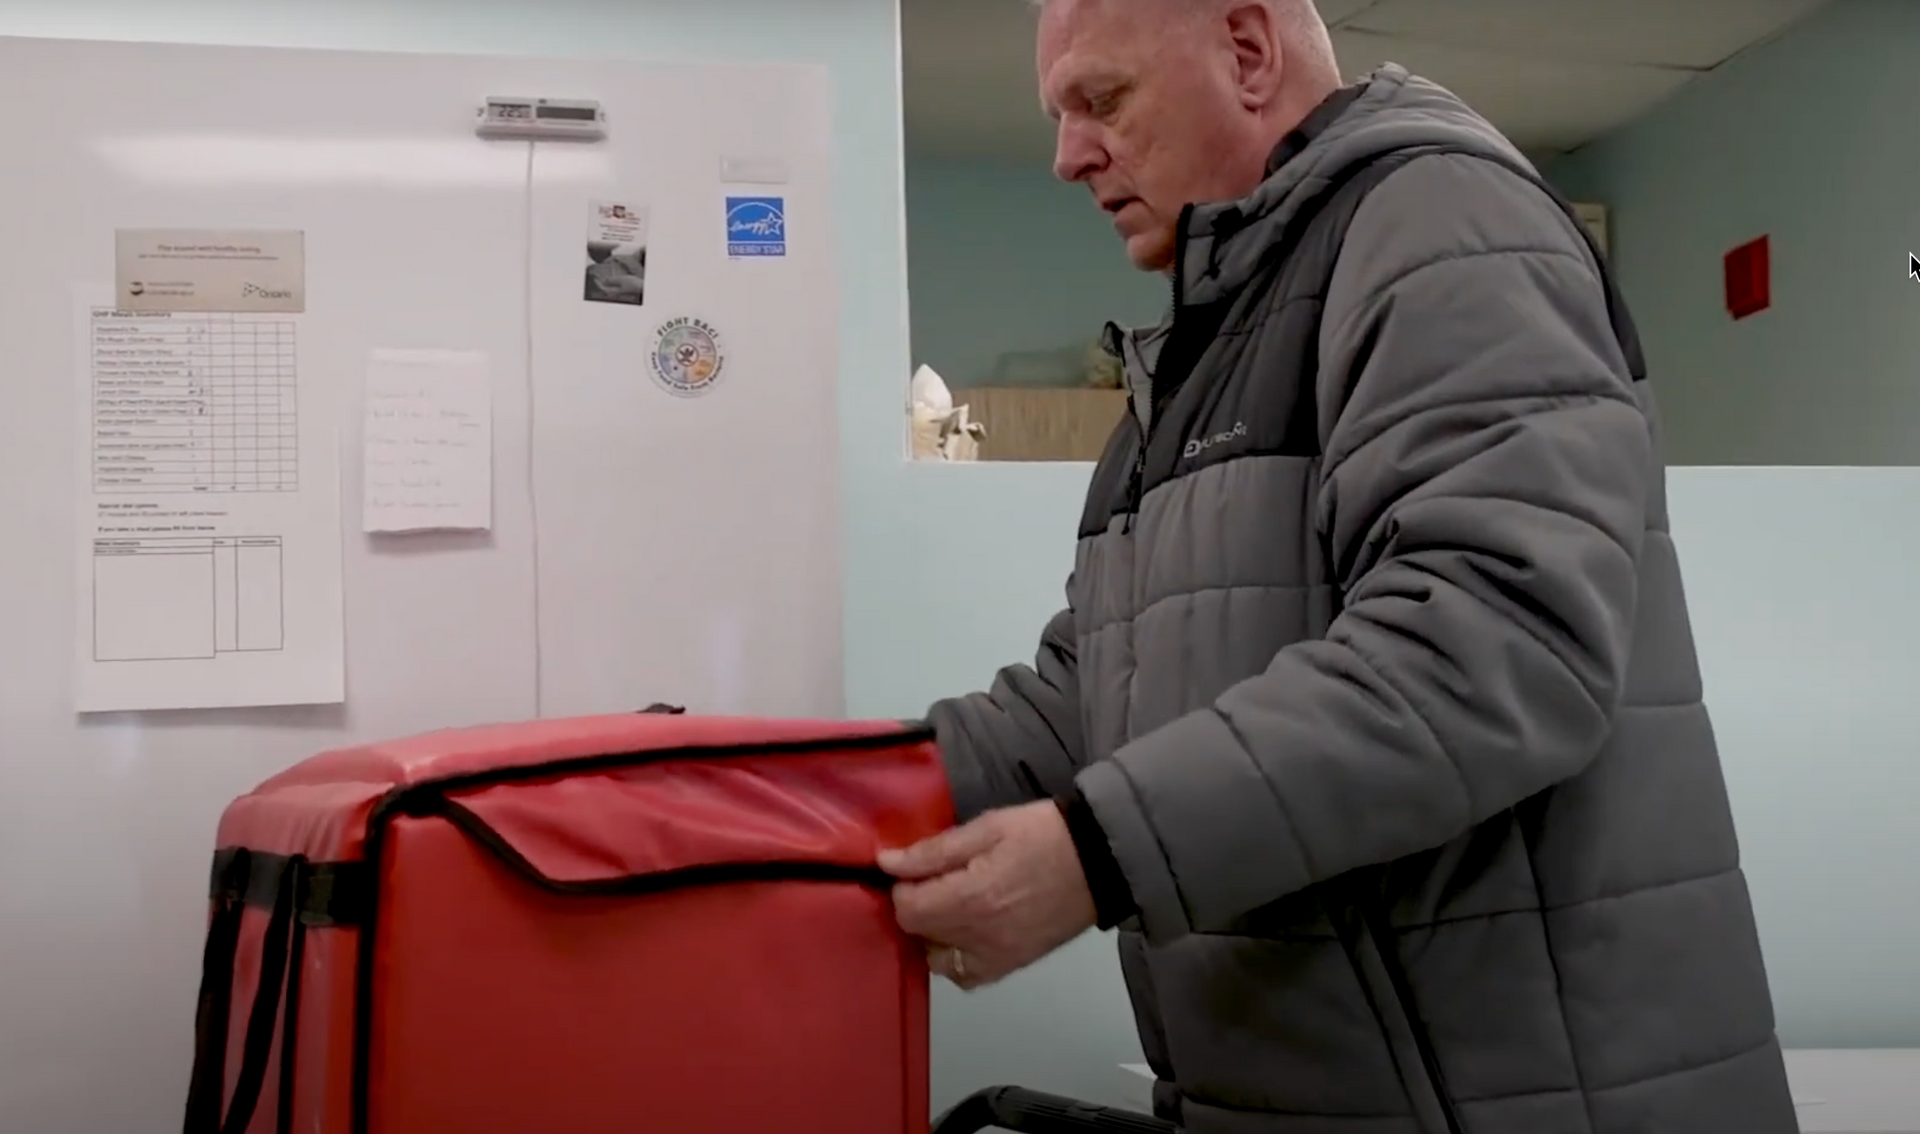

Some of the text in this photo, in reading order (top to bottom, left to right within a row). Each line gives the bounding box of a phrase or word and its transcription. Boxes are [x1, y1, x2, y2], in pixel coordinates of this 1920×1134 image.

[729, 244, 783, 254] ENERGY STAR
[259, 290, 292, 299] Ontario
[657, 317, 689, 337] FIGHT
